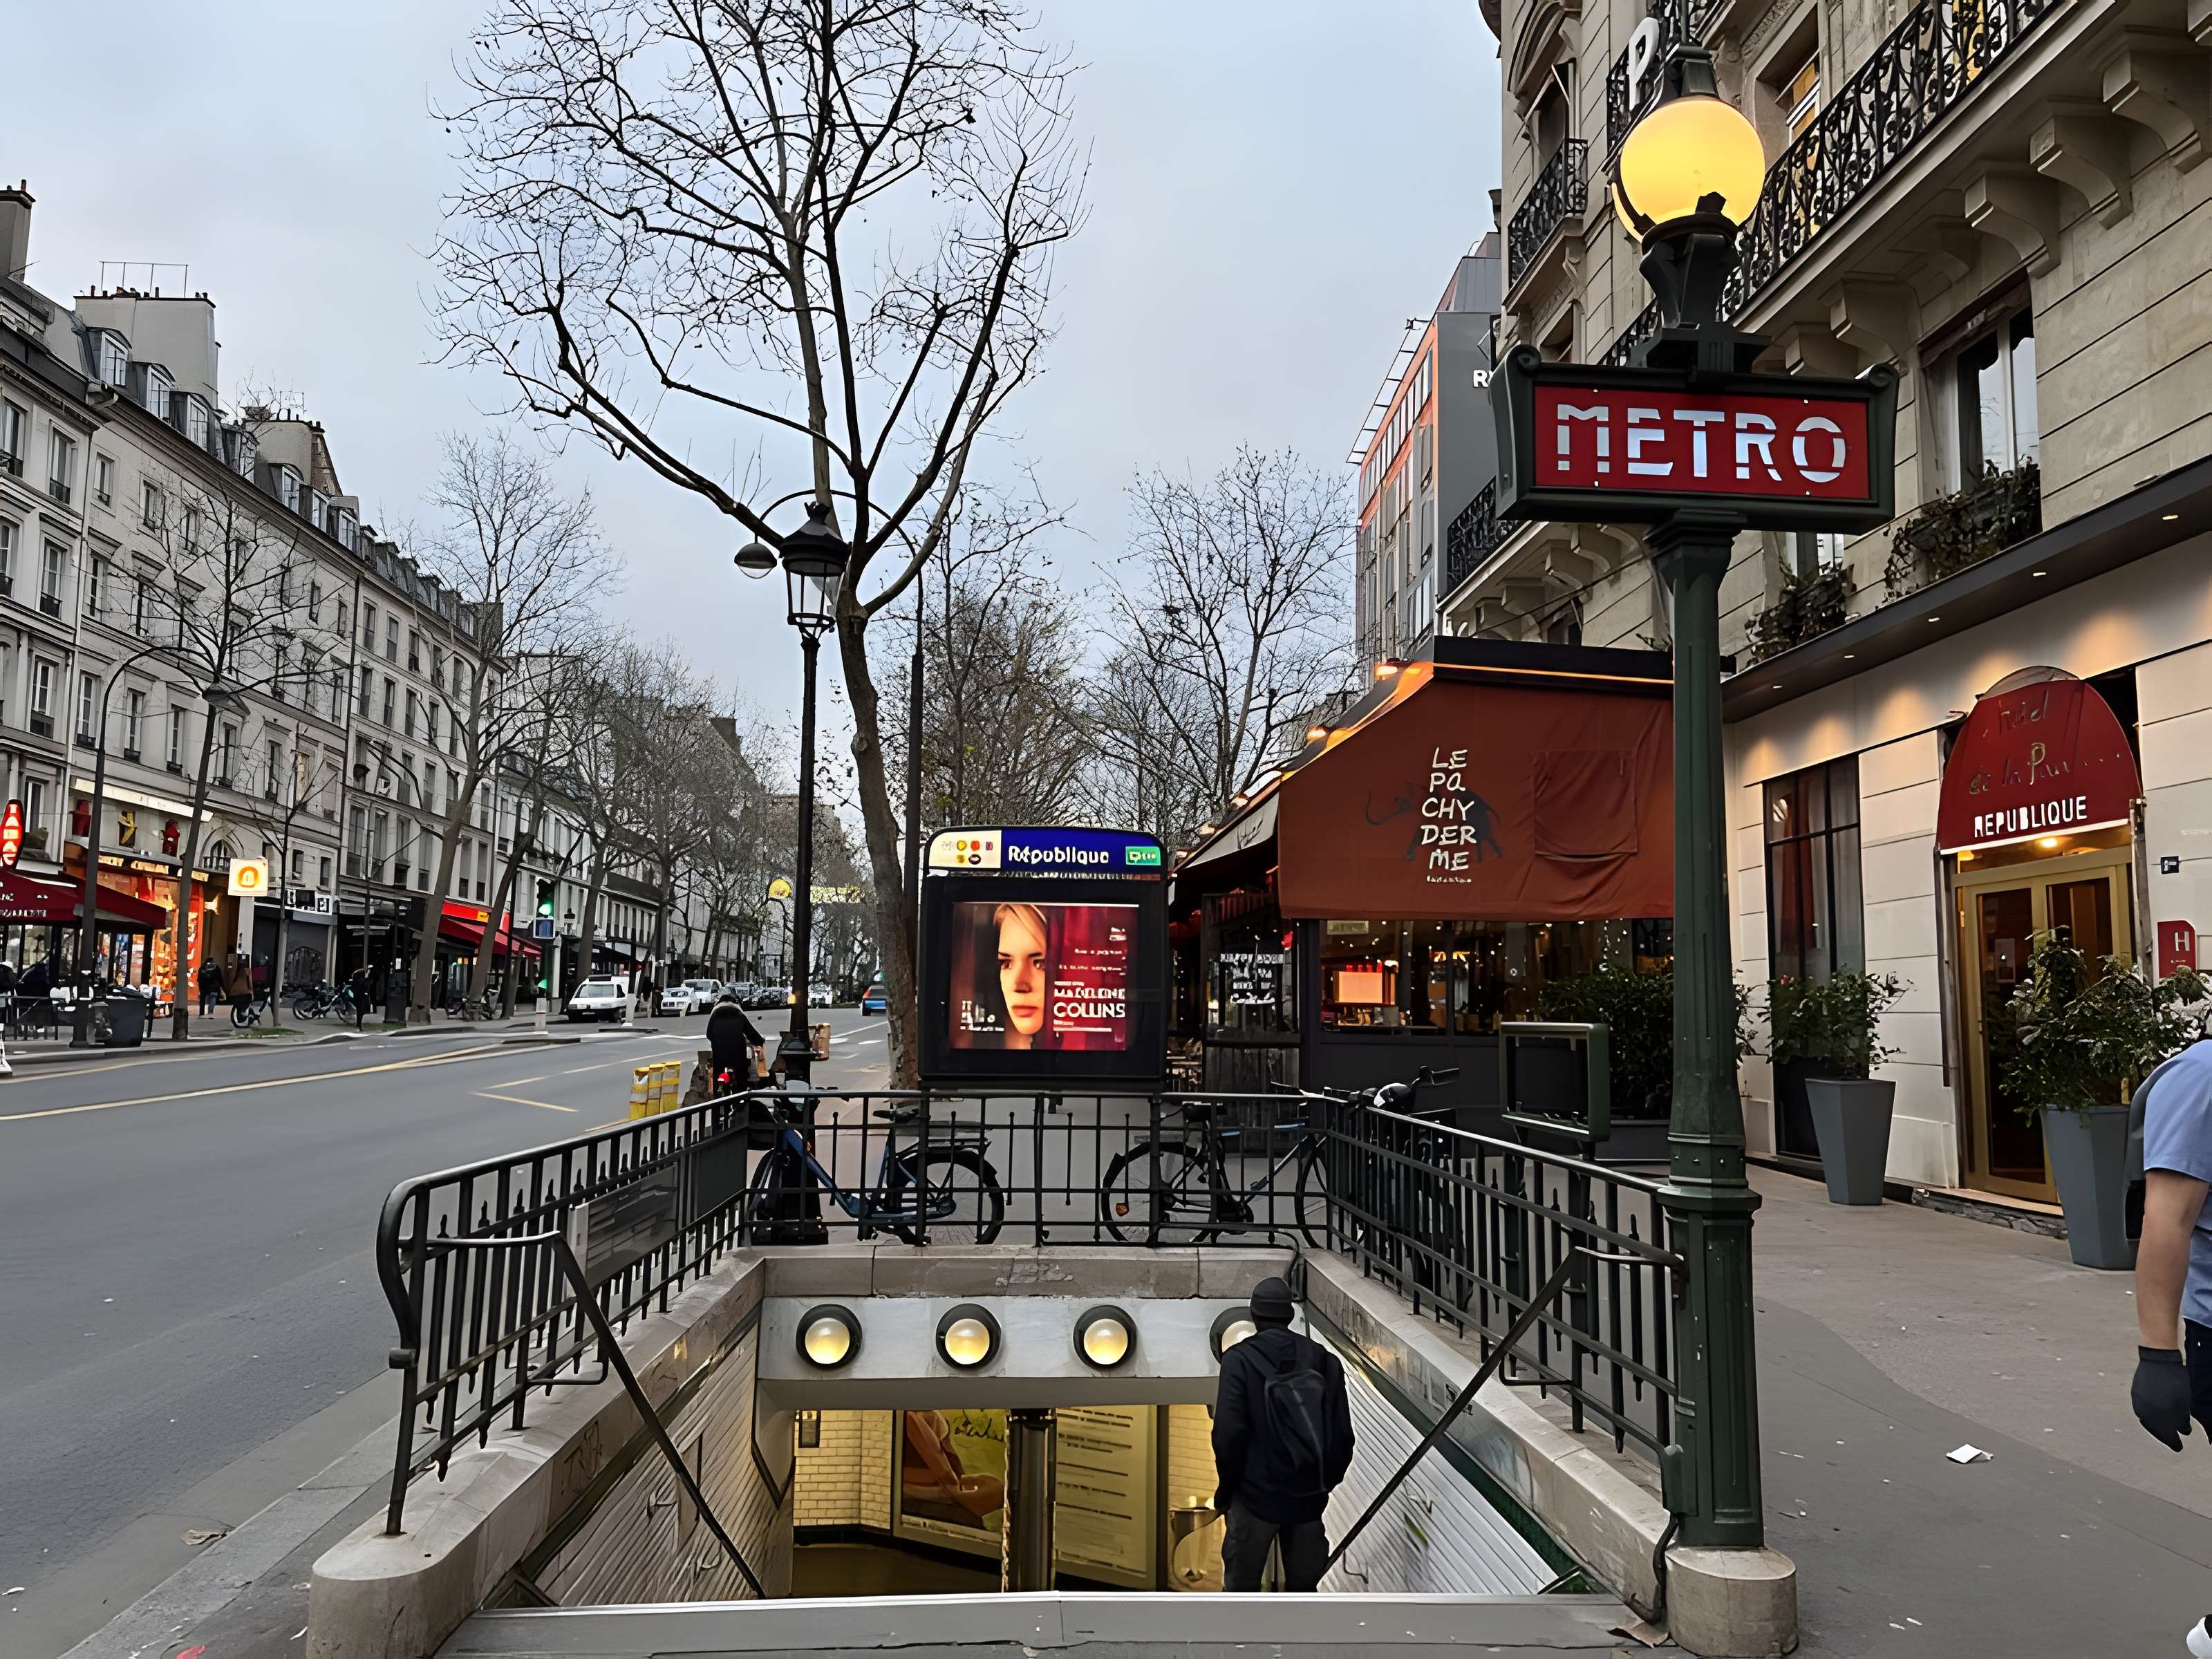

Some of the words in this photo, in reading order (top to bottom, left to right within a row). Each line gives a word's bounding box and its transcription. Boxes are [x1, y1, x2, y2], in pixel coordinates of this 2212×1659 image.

[1557, 404, 1846, 482] METRO
[1432, 747, 1468, 769] LE
[1421, 797, 1475, 821] CHY
[1974, 796, 2088, 838] REPUBLIQUE
[1421, 825, 1477, 845] DER
[1429, 848, 1470, 871] ME
[2174, 931, 2191, 953] H
[1053, 1002, 1126, 1018] COLLINS
